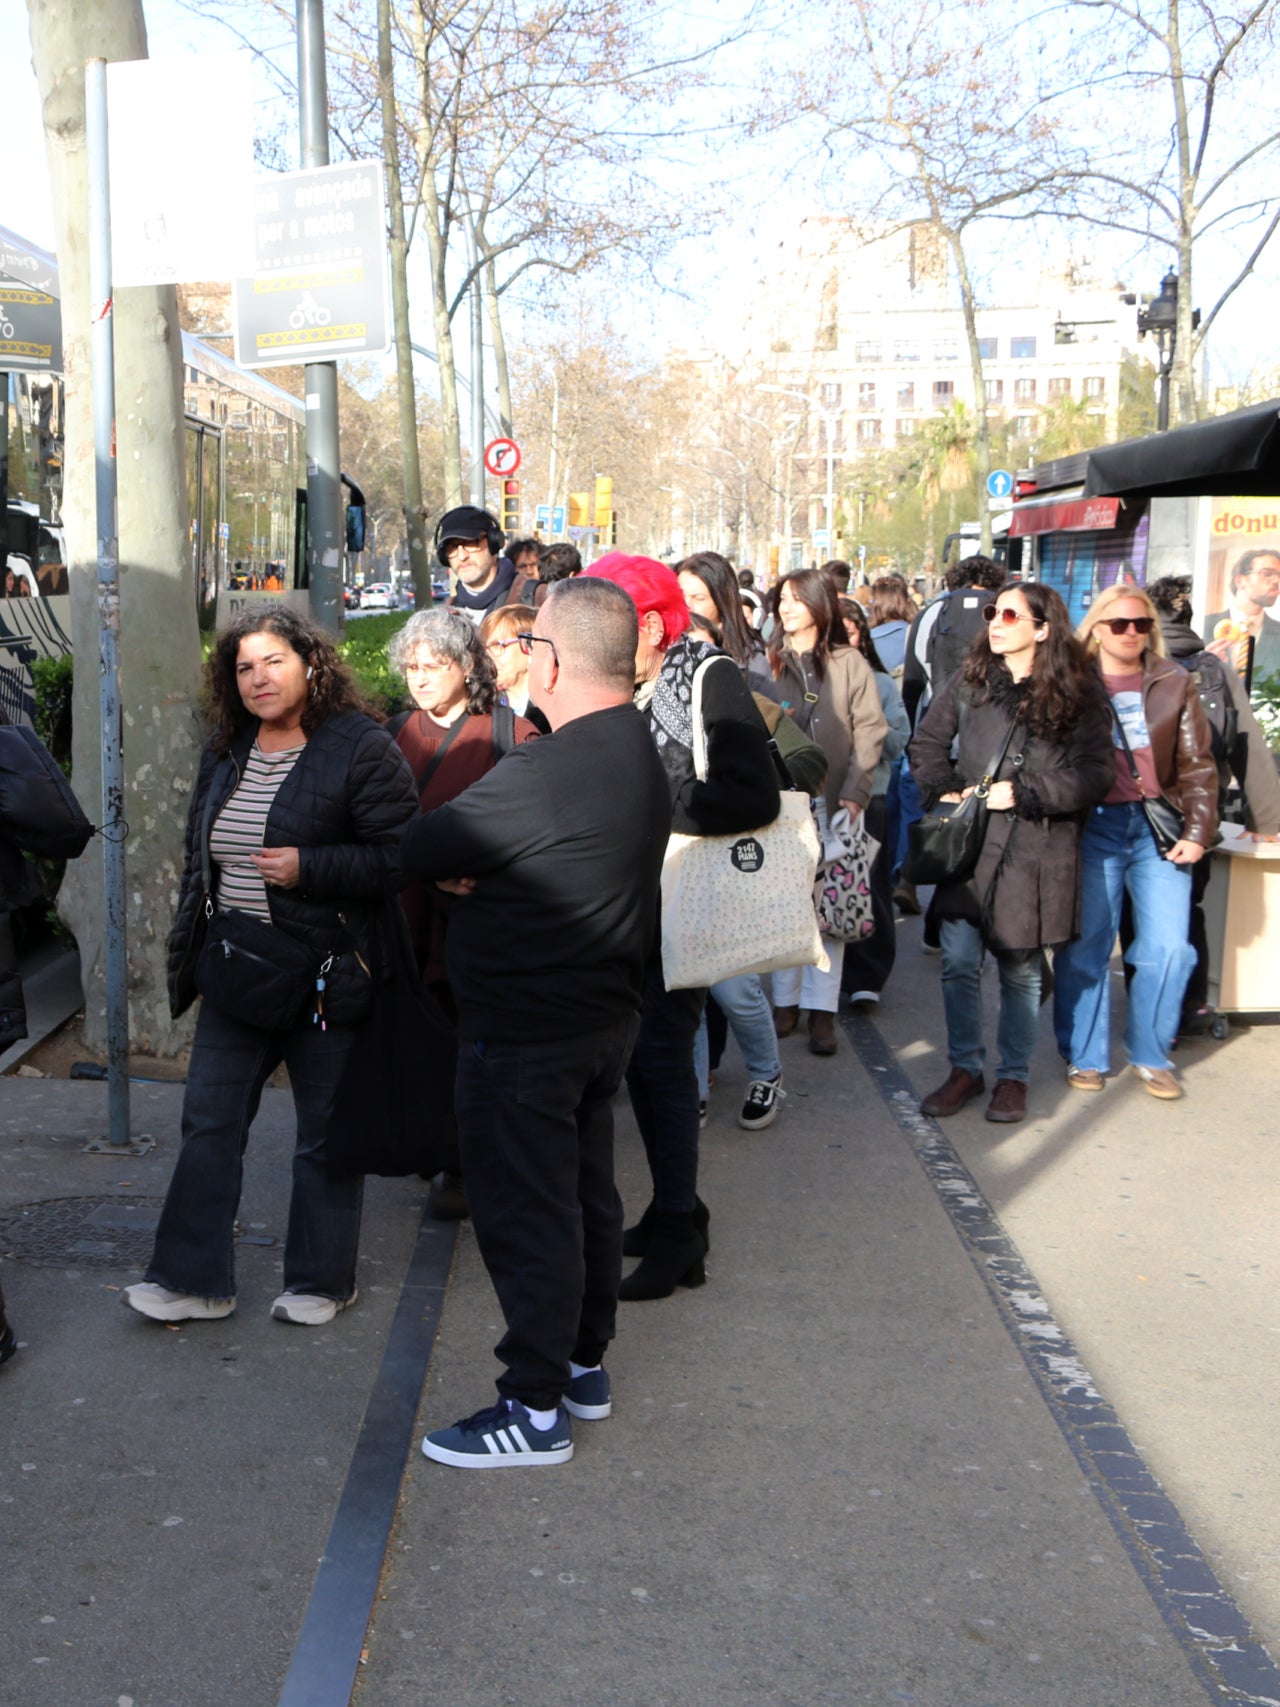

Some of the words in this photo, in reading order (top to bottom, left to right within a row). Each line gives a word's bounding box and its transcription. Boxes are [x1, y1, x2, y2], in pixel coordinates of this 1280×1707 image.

[295, 172, 372, 208] avançada
[258, 221, 285, 249] per
[289, 219, 299, 239] a
[303, 210, 355, 237] motos
[1214, 512, 1278, 533] donu
